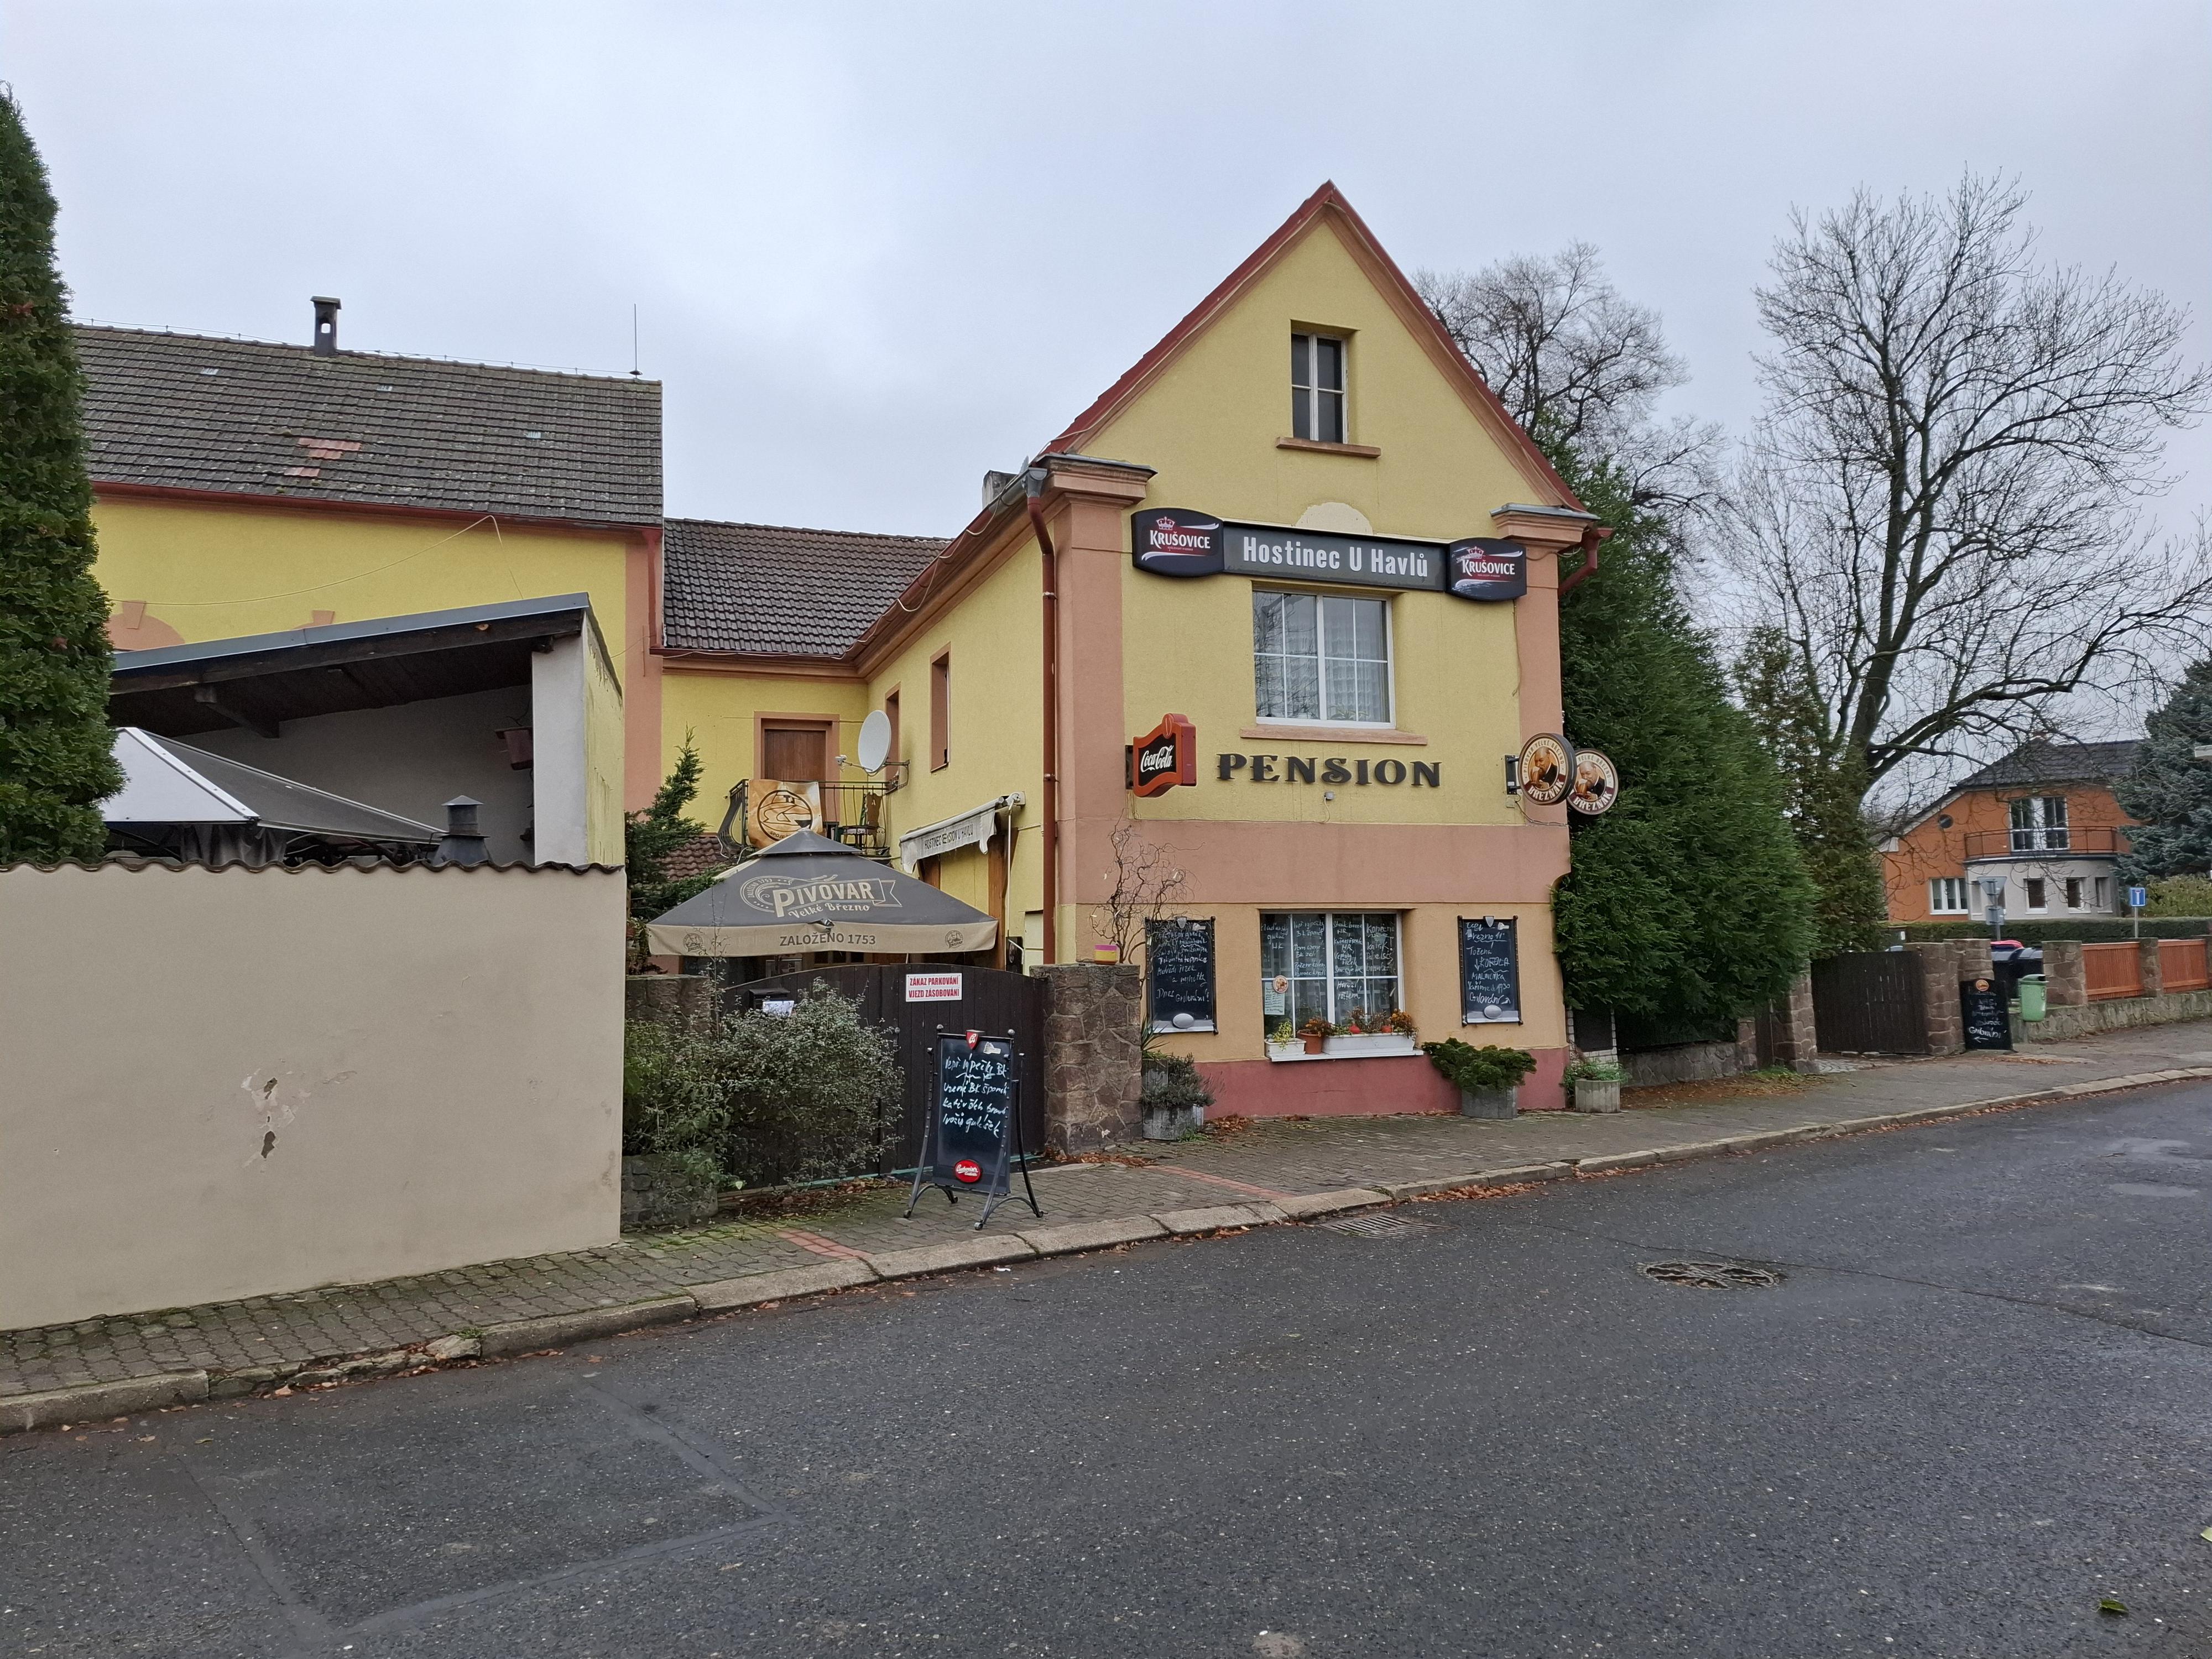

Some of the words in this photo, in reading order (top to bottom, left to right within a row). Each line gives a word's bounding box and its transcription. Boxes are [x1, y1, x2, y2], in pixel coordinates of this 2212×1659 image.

[1150, 530, 1211, 549] KRUŠOVICE
[1244, 536, 1340, 570] Hostinec
[1349, 546, 1363, 572] U
[1371, 549, 1428, 577] Havlů
[1462, 559, 1516, 577] KRUŠOVICE
[1216, 753, 1443, 787] PENSION
[772, 881, 875, 918] PIVOVAR
[788, 904, 822, 919] Velké
[825, 902, 870, 912] Březno
[780, 932, 844, 946] ZALOŽENO
[847, 933, 876, 945] 1753
[910, 976, 927, 986] ZÁKAZ
[928, 975, 959, 985] PARKOVÁNÍ
[909, 989, 924, 998] VJEZD
[925, 987, 960, 998] ZÁSOBOVÁNÍ
